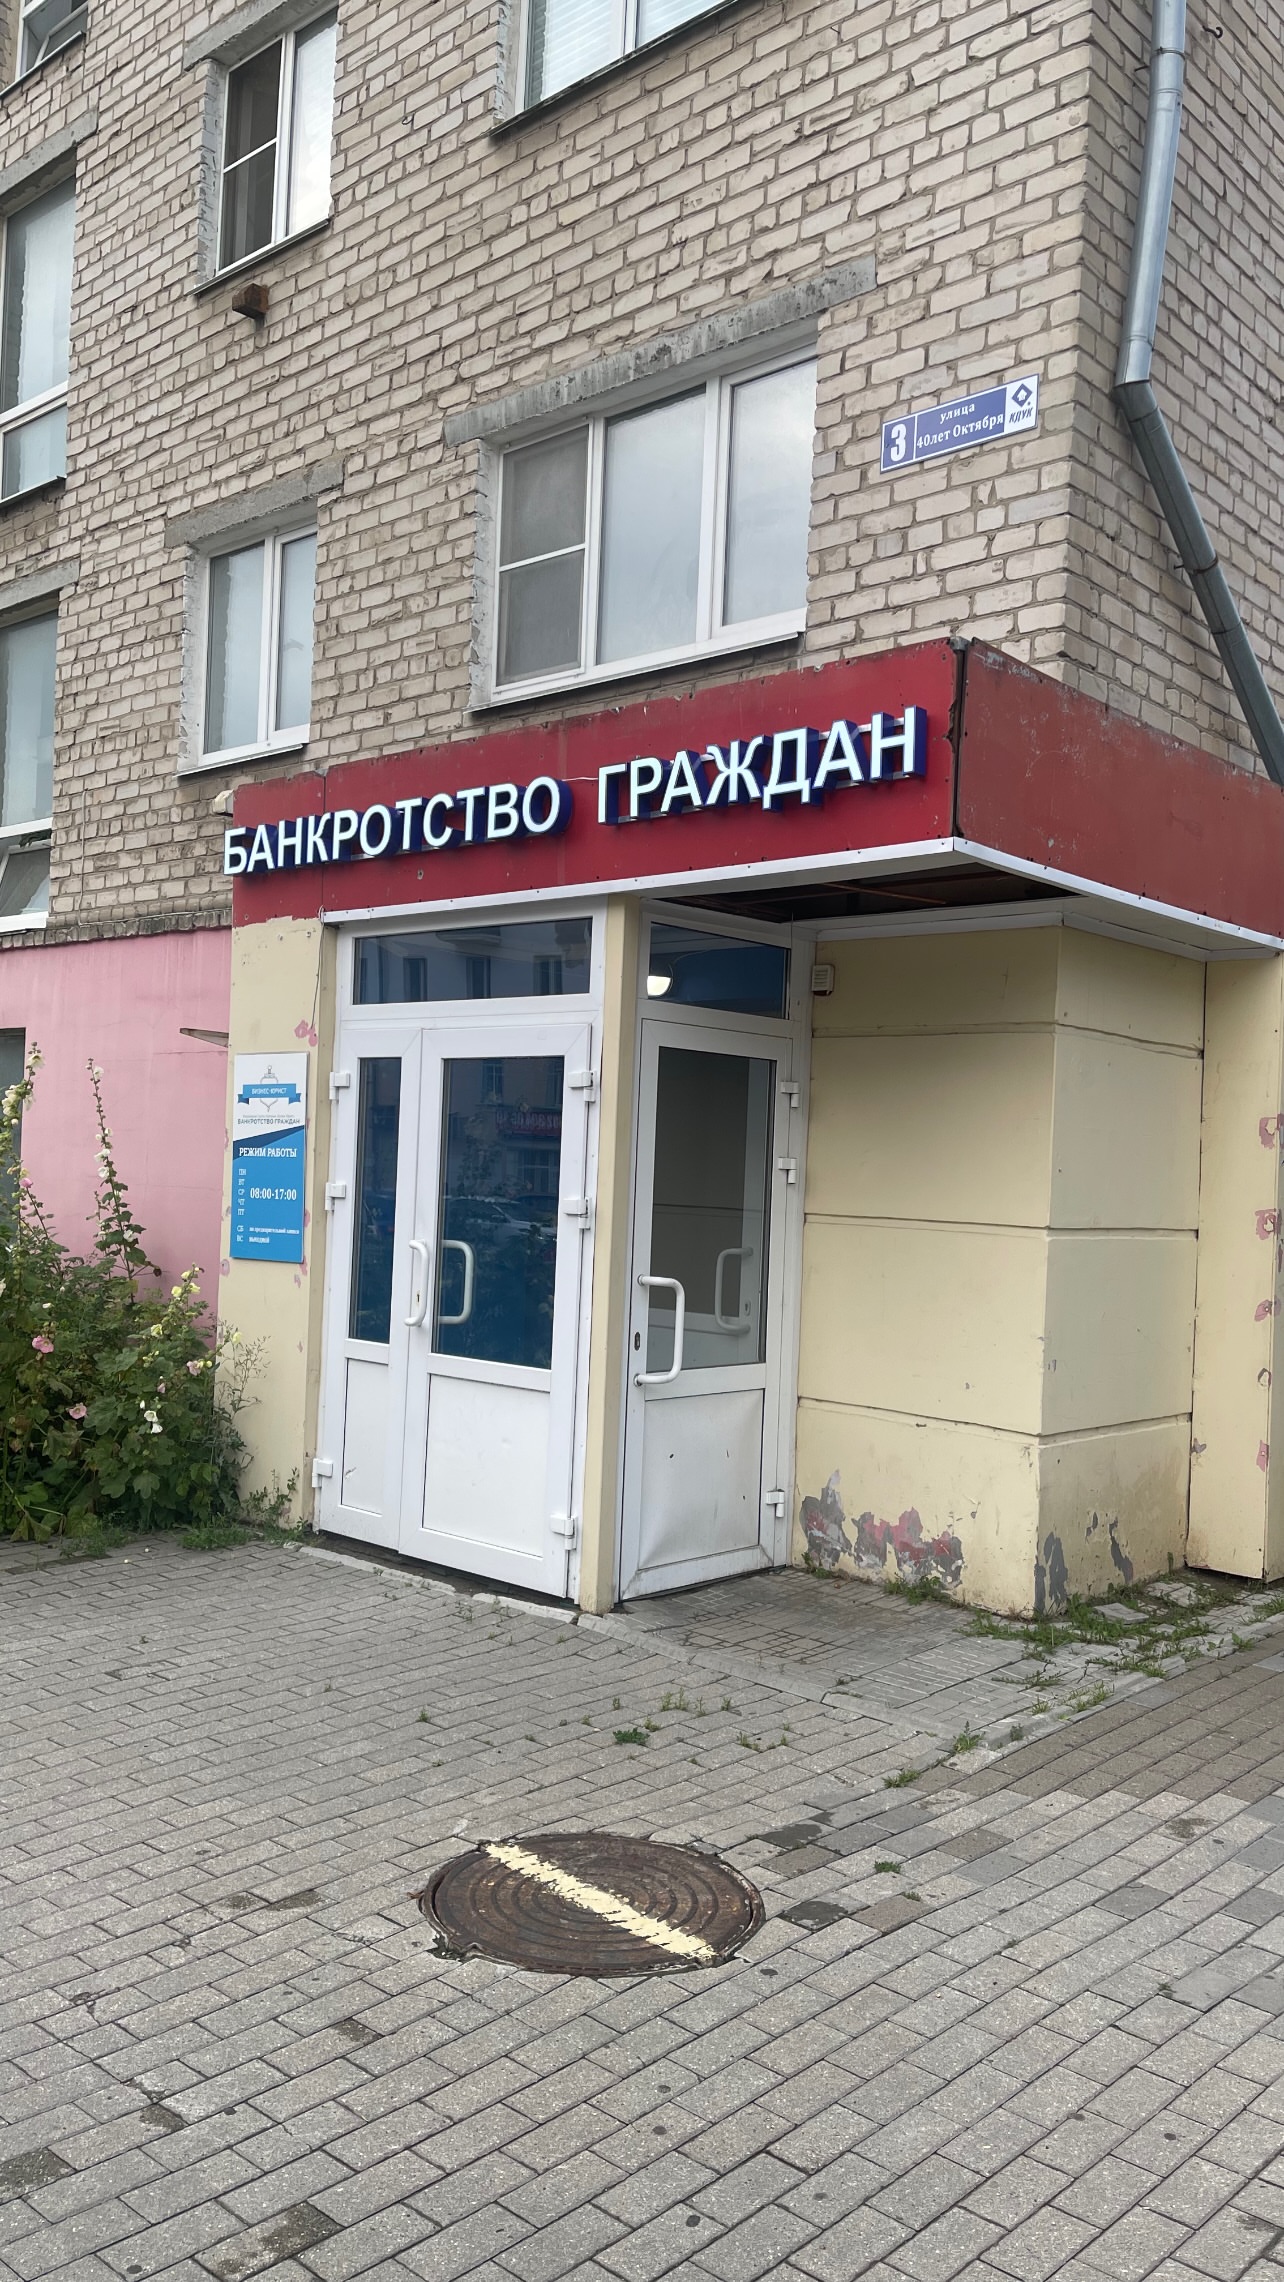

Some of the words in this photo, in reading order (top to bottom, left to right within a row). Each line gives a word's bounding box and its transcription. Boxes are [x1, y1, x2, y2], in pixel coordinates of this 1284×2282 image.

[939, 402, 976, 425] улица
[890, 423, 907, 462] 3
[916, 428, 951, 449] 40лет
[952, 412, 1004, 438] Октября
[222, 775, 562, 876] БАНКРОТСТВО
[597, 705, 927, 826] ГРАЖДАН
[239, 1147, 266, 1157] РЕЖИМ
[267, 1147, 297, 1158] РАБОТЫ
[250, 1187, 297, 1200] 08:00-17:00
